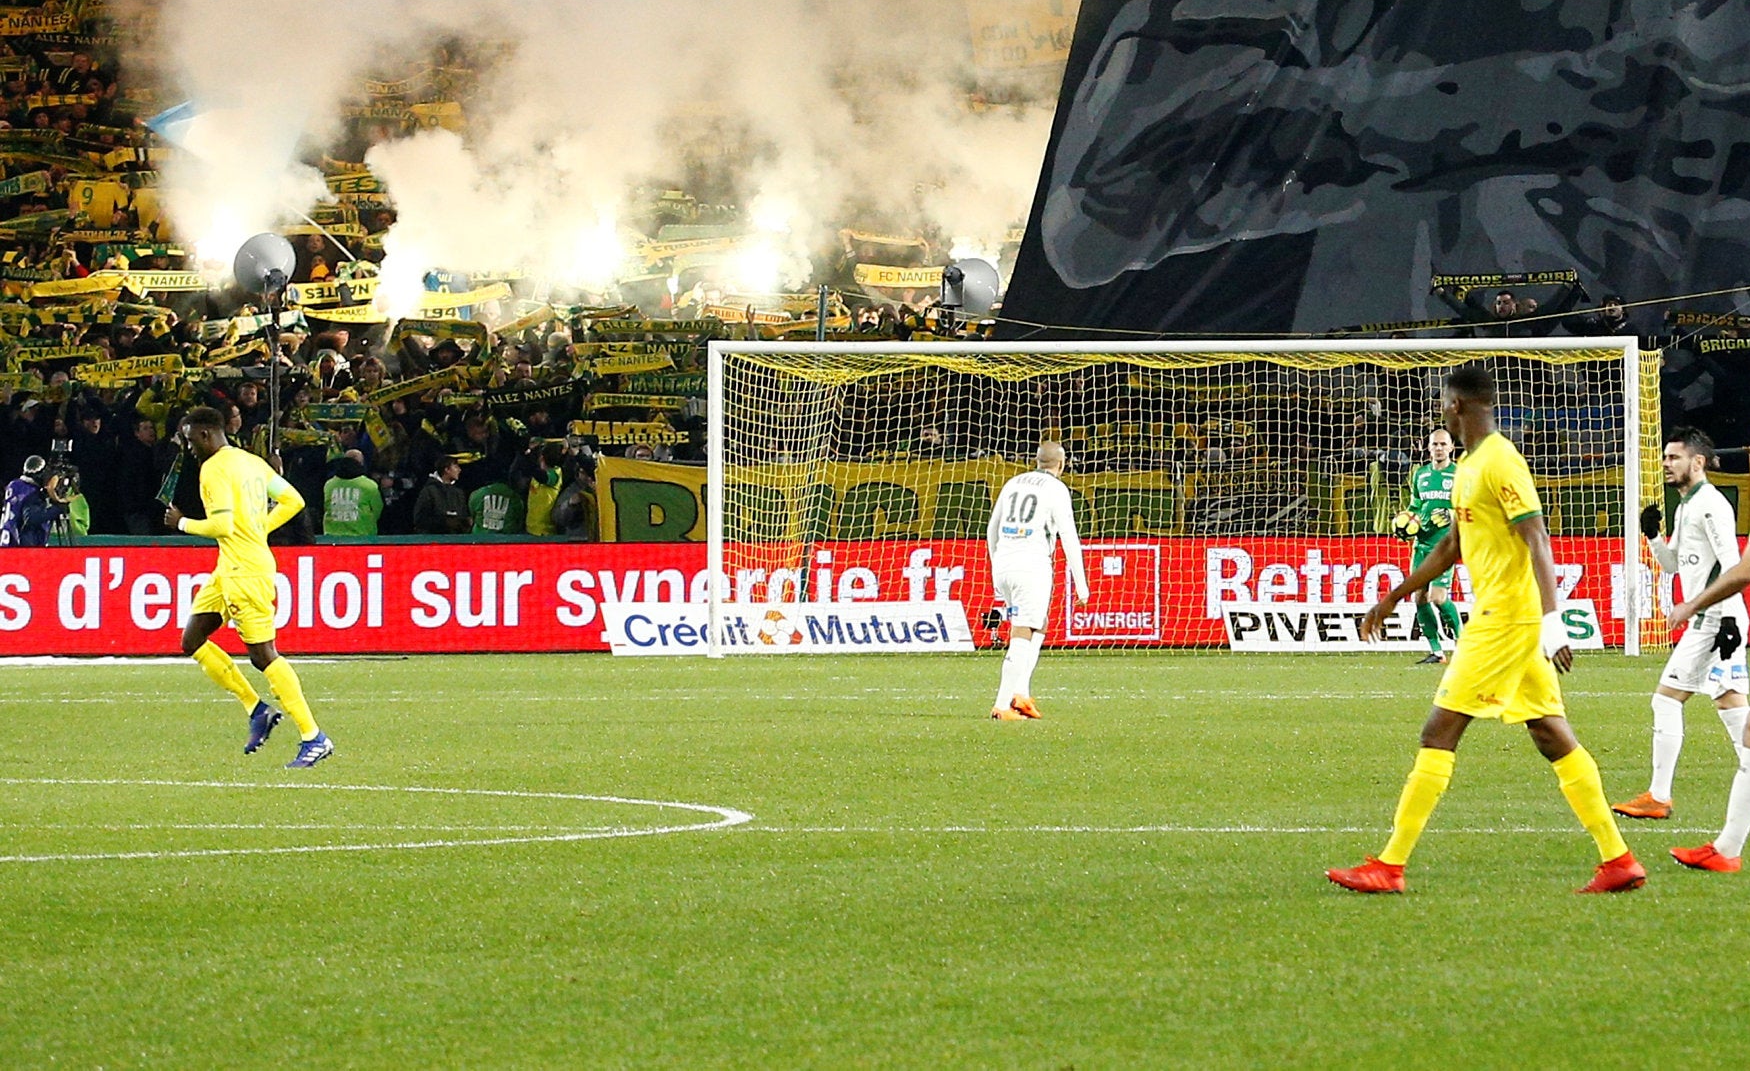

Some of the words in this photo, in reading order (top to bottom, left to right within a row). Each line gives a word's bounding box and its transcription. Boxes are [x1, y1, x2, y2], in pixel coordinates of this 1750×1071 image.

[81, 187, 94, 205] 9
[149, 275, 200, 286] NANTES
[878, 271, 894, 281] FC
[897, 271, 943, 282] NANTES
[1433, 273, 1503, 288] BRIGADE
[1527, 269, 1576, 283] LOIRE
[93, 361, 121, 373] MUR
[129, 356, 166, 370] JAUNE
[601, 357, 616, 367] FC
[617, 353, 661, 366] NANTES
[524, 383, 574, 401] NANTES
[597, 431, 690, 446] BRIGADE
[1006, 491, 1039, 523] 10
[411, 570, 534, 631] sur
[805, 612, 949, 646] Mutuel
[1073, 611, 1153, 629] SYNERGIE
